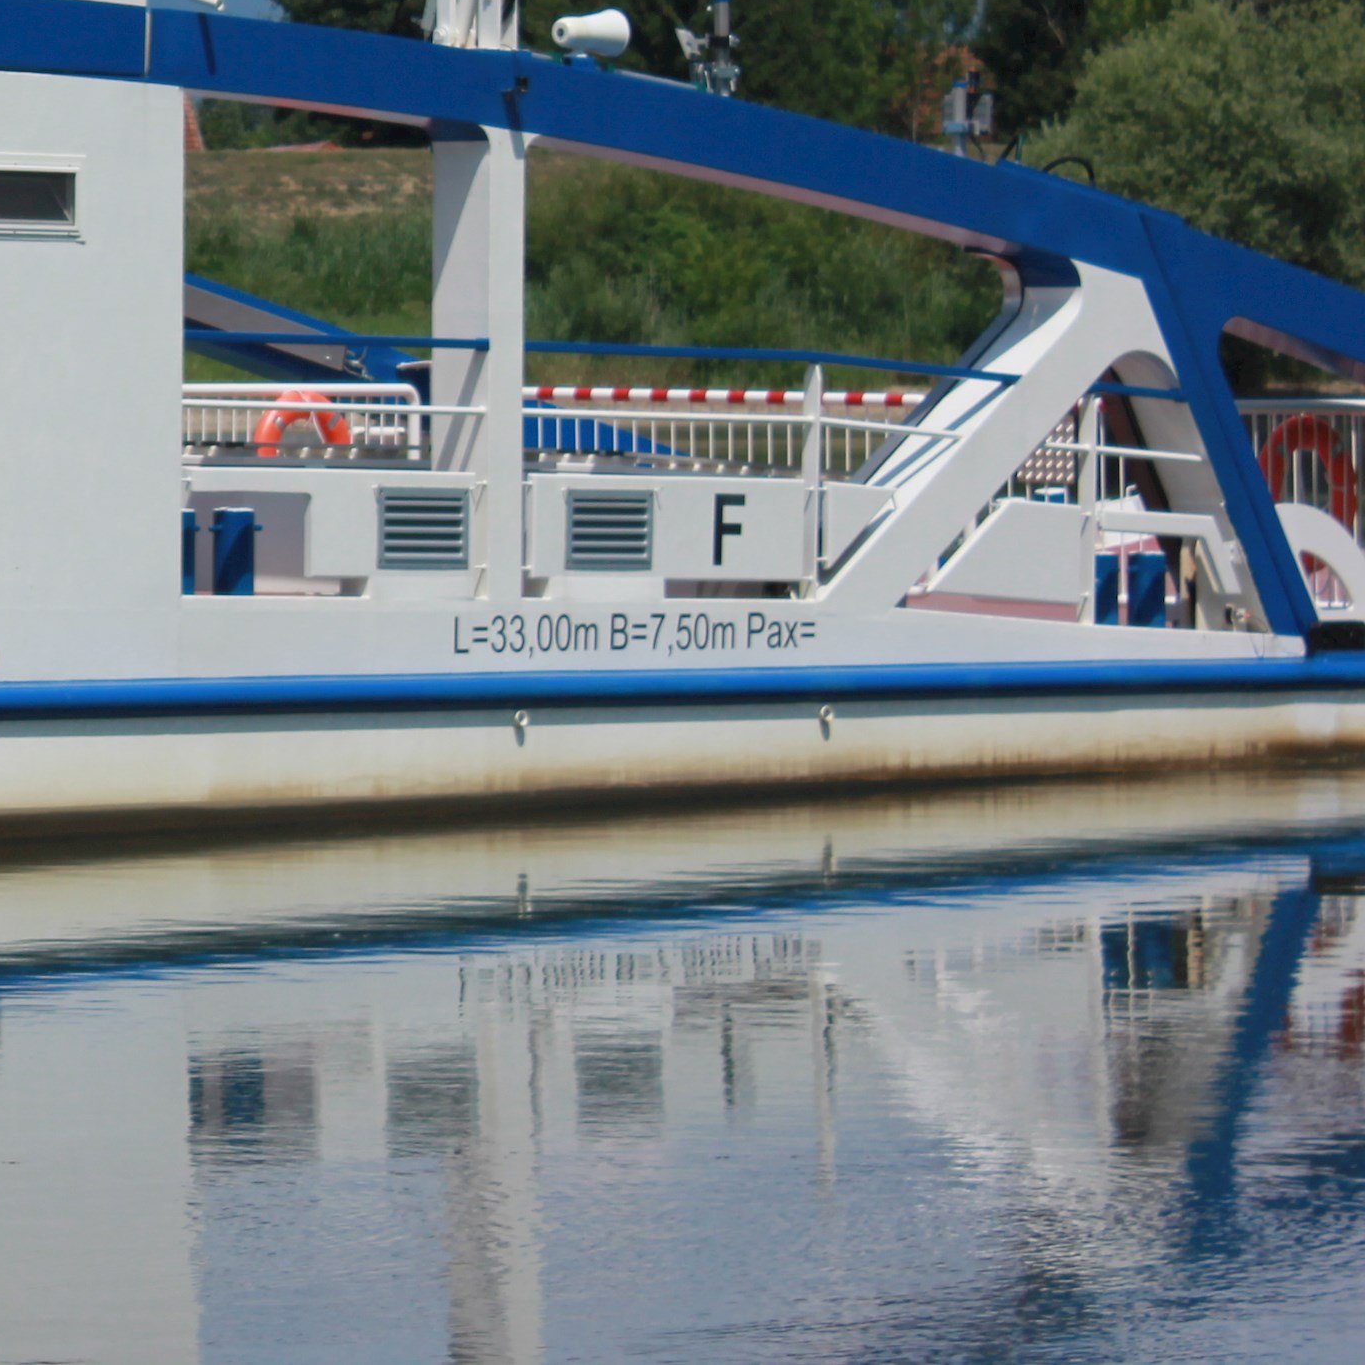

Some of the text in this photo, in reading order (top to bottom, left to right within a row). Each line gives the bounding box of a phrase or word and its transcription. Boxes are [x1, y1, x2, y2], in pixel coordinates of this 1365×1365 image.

[712, 493, 746, 566] F
[453, 611, 817, 658] L=33,00m B=7,50m Pax=
